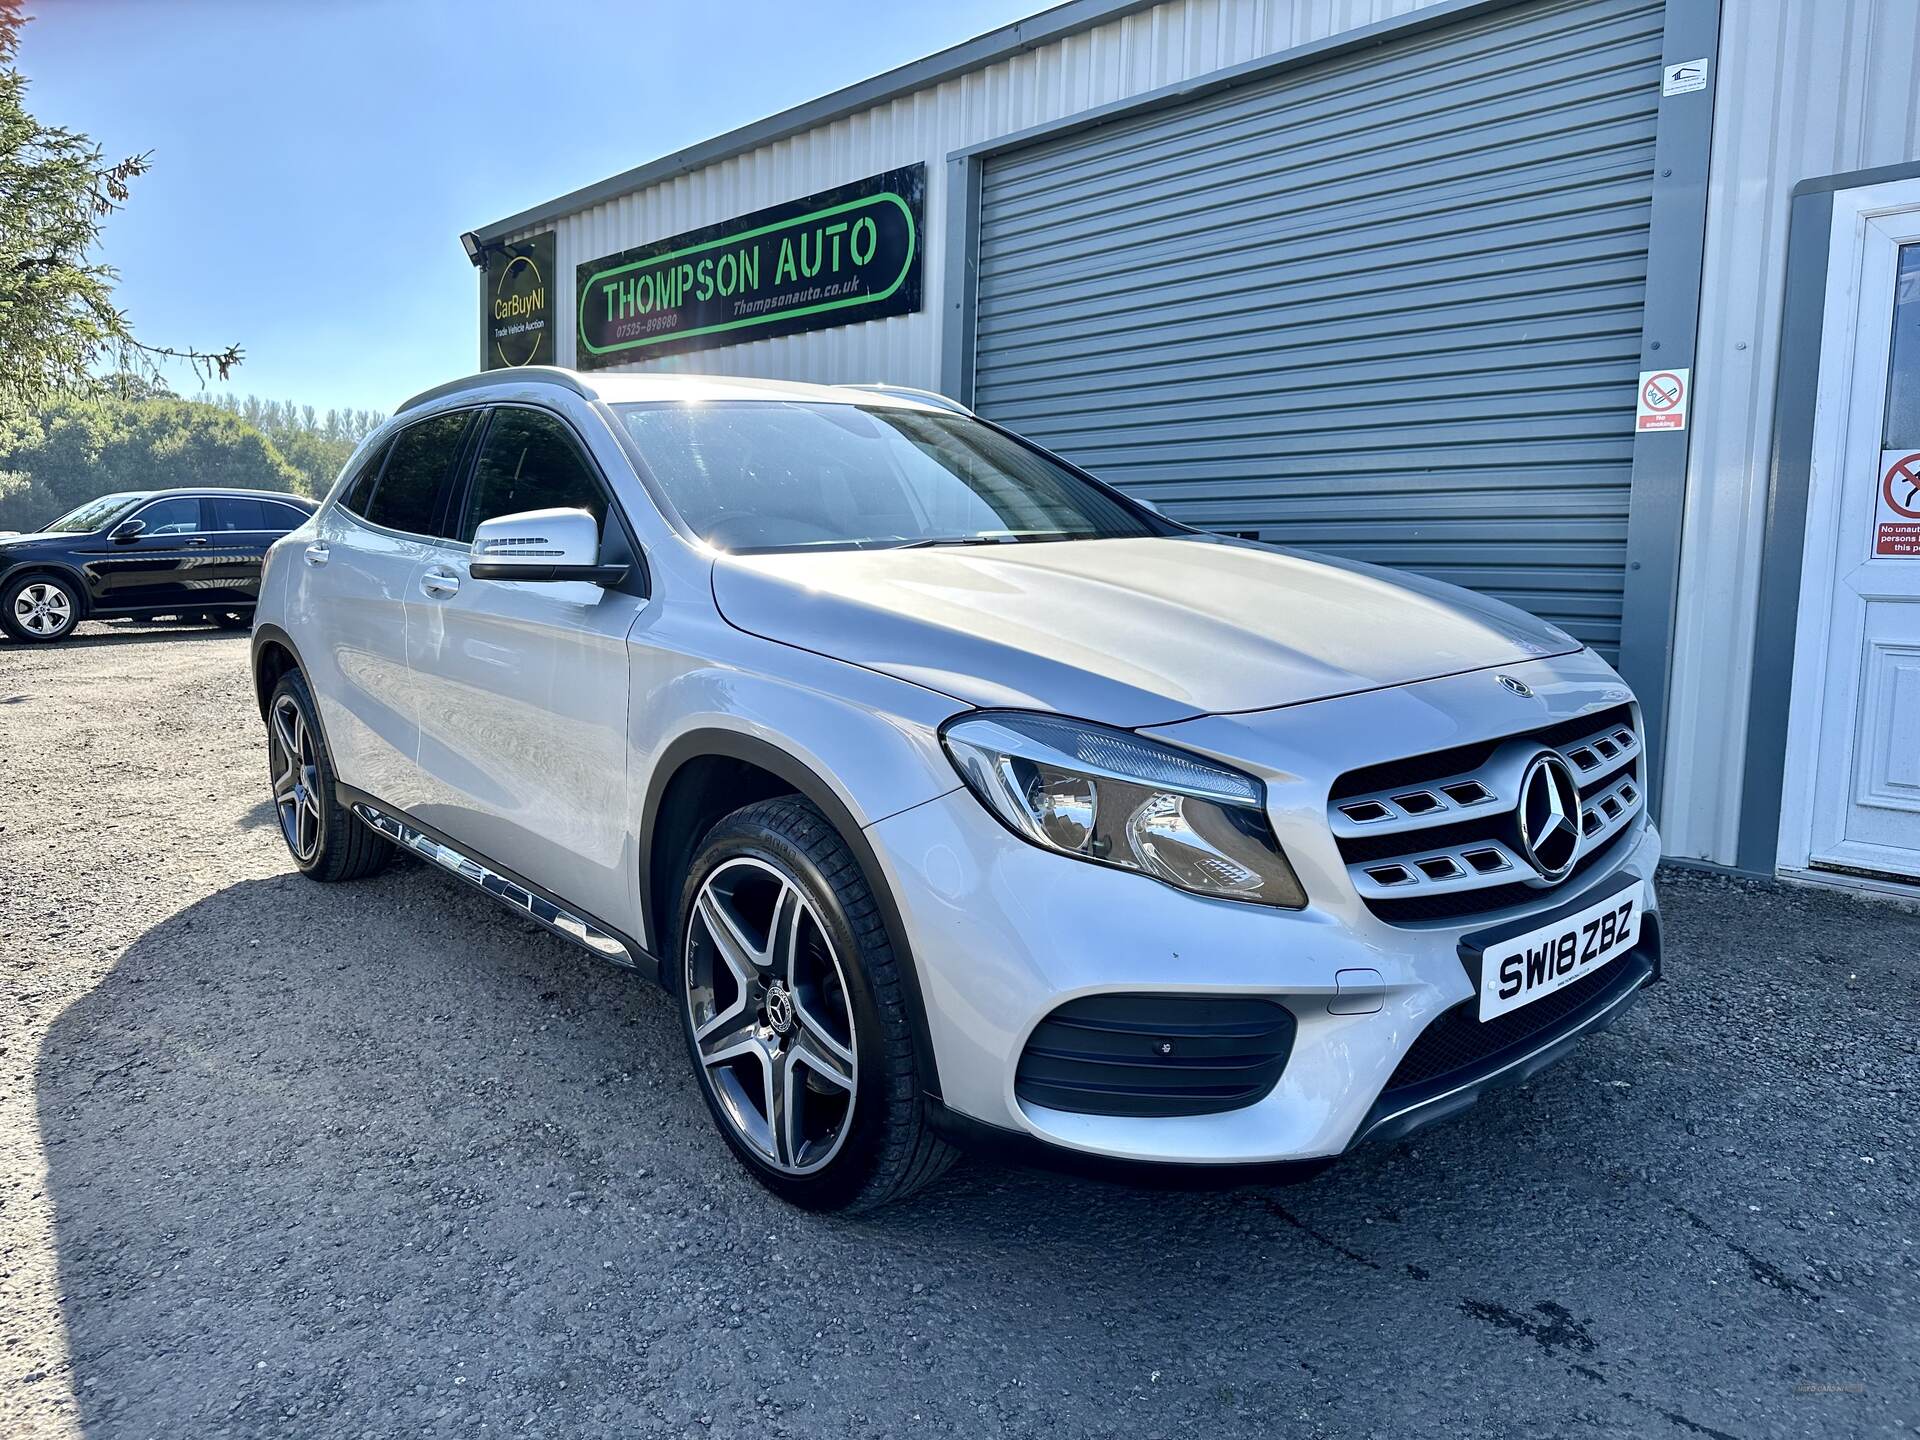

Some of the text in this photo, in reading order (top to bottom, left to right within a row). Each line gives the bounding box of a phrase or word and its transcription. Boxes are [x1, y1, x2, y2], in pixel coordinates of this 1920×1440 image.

[602, 216, 878, 323] THOMPSON AUTO
[494, 287, 545, 320] CarBuyNI
[733, 274, 860, 316] Thompsonauto.co.uk
[495, 319, 545, 338] Trade Vehicle Auction
[616, 313, 678, 339] 07525-898980
[1880, 535, 1917, 543] persons
[1881, 525, 1894, 533] No
[1498, 899, 1634, 1001] SW18 ZBZ
